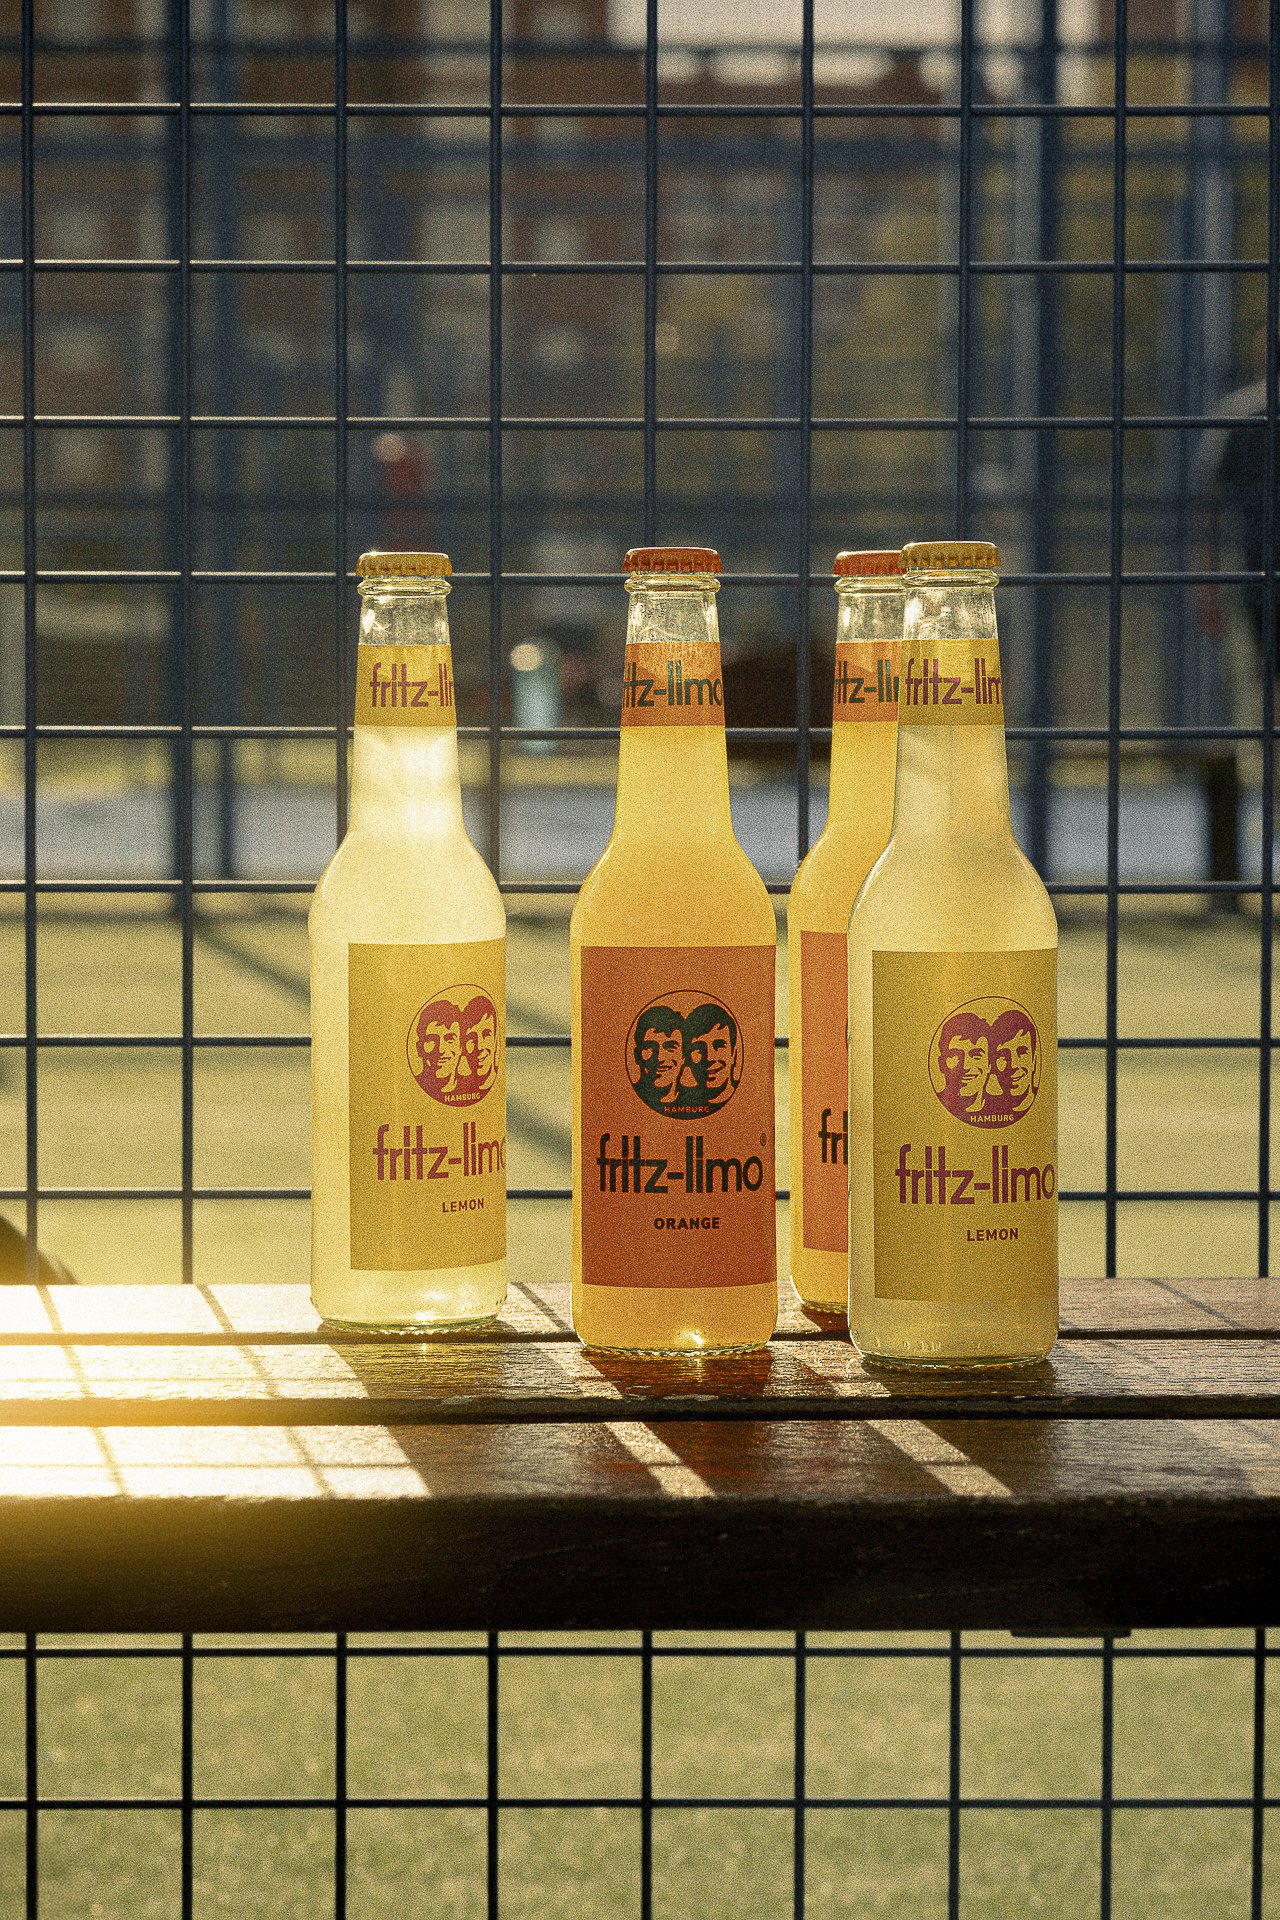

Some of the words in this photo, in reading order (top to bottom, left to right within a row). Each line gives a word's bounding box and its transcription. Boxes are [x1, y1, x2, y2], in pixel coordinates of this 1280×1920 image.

[444, 1092, 481, 1102] HAMBURG
[663, 1105, 710, 1113] HAMBURG
[970, 1113, 1014, 1123] HAMBURG
[596, 1133, 763, 1194] fritz-limo
[895, 1143, 1055, 1205] fritz-limo
[441, 1198, 485, 1213] LEMON
[654, 1217, 720, 1230] ORANGE
[967, 1227, 1019, 1242] LEMON
